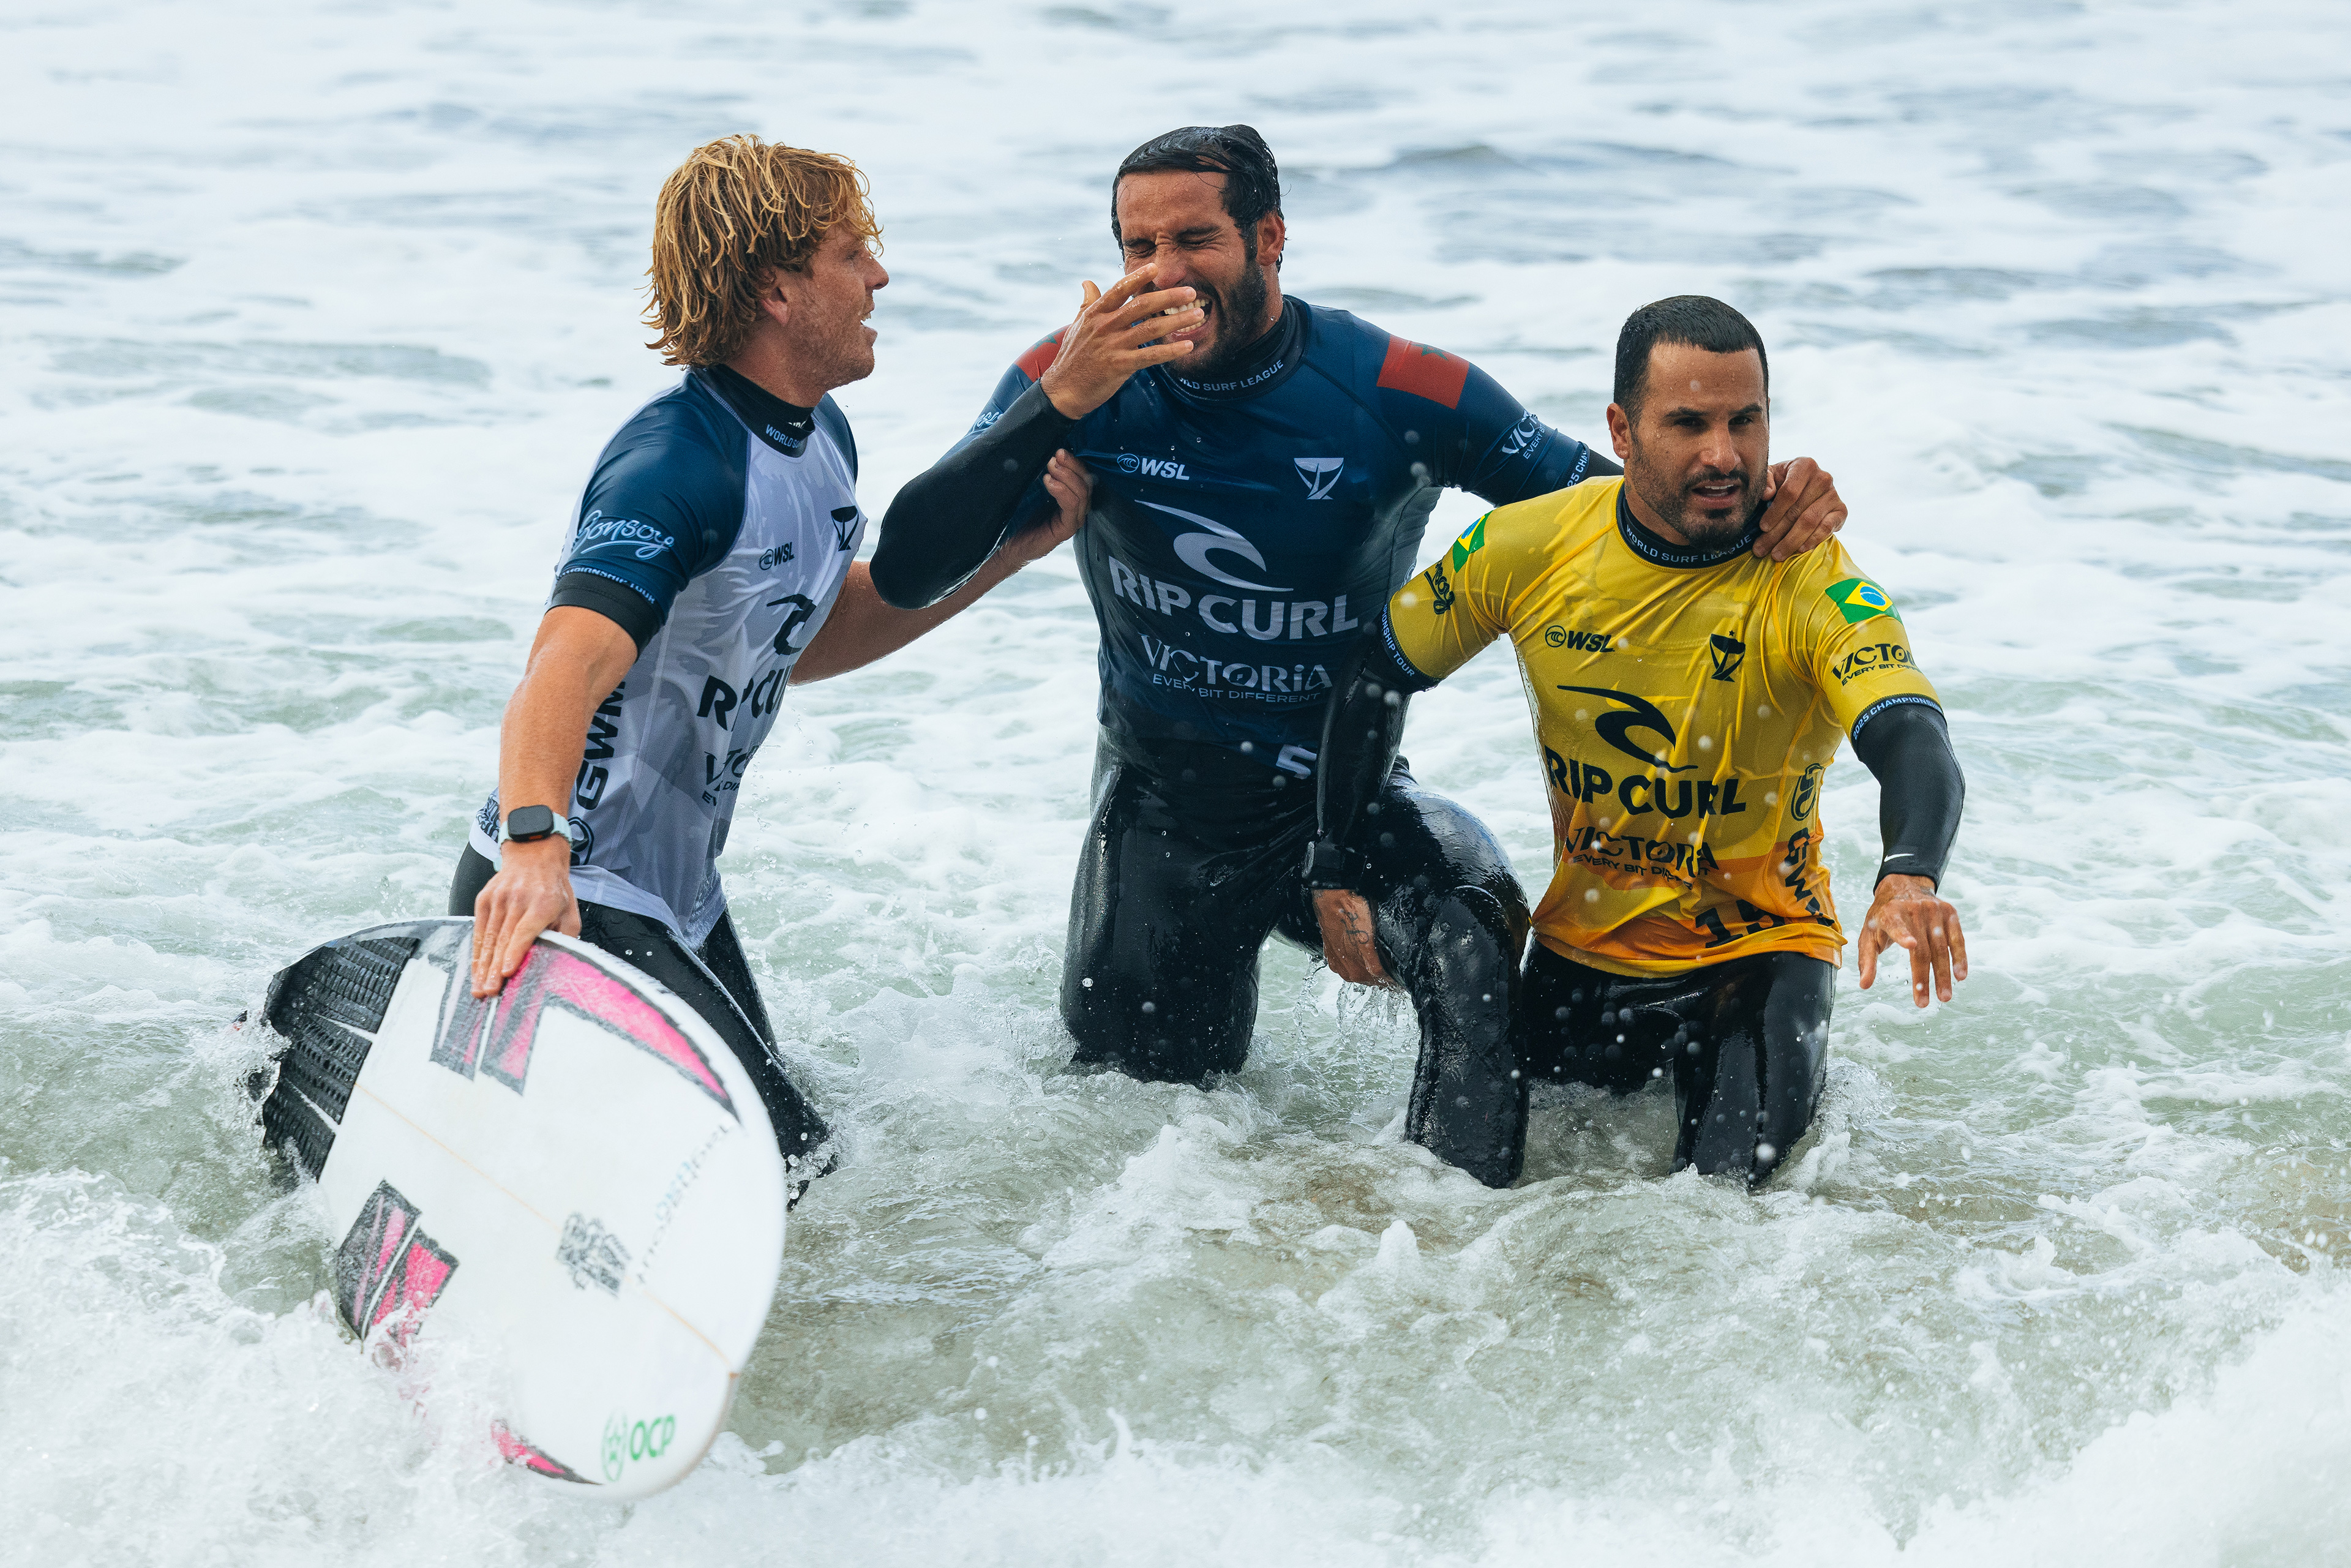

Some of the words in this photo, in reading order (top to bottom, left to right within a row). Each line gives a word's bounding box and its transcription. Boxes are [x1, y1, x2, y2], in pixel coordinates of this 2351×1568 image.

[1202, 382, 1237, 391] SURF
[1240, 359, 1284, 388] LEAGUE
[765, 424, 794, 447] WORLD
[1523, 431, 1543, 459] EVERY
[1141, 457, 1190, 481] WSL
[774, 541, 795, 566] WSL
[1626, 524, 1659, 558] WORLD
[1661, 552, 1699, 563] SURF
[1108, 555, 1191, 616] RIP
[1198, 594, 1359, 640] CURL
[1567, 630, 1616, 653] WSL
[1393, 651, 1415, 677] TOUR
[1841, 665, 1876, 686] EVERY
[1199, 688, 1224, 699] BIT
[1229, 690, 1321, 703] DIFFERENT
[1853, 713, 1870, 740] 2025
[1544, 745, 1613, 805] RIP
[1618, 775, 1747, 819] CURL
[1573, 854, 1621, 870] EVERY
[1624, 864, 1648, 876] BIT
[629, 1412, 676, 1461] OCP
